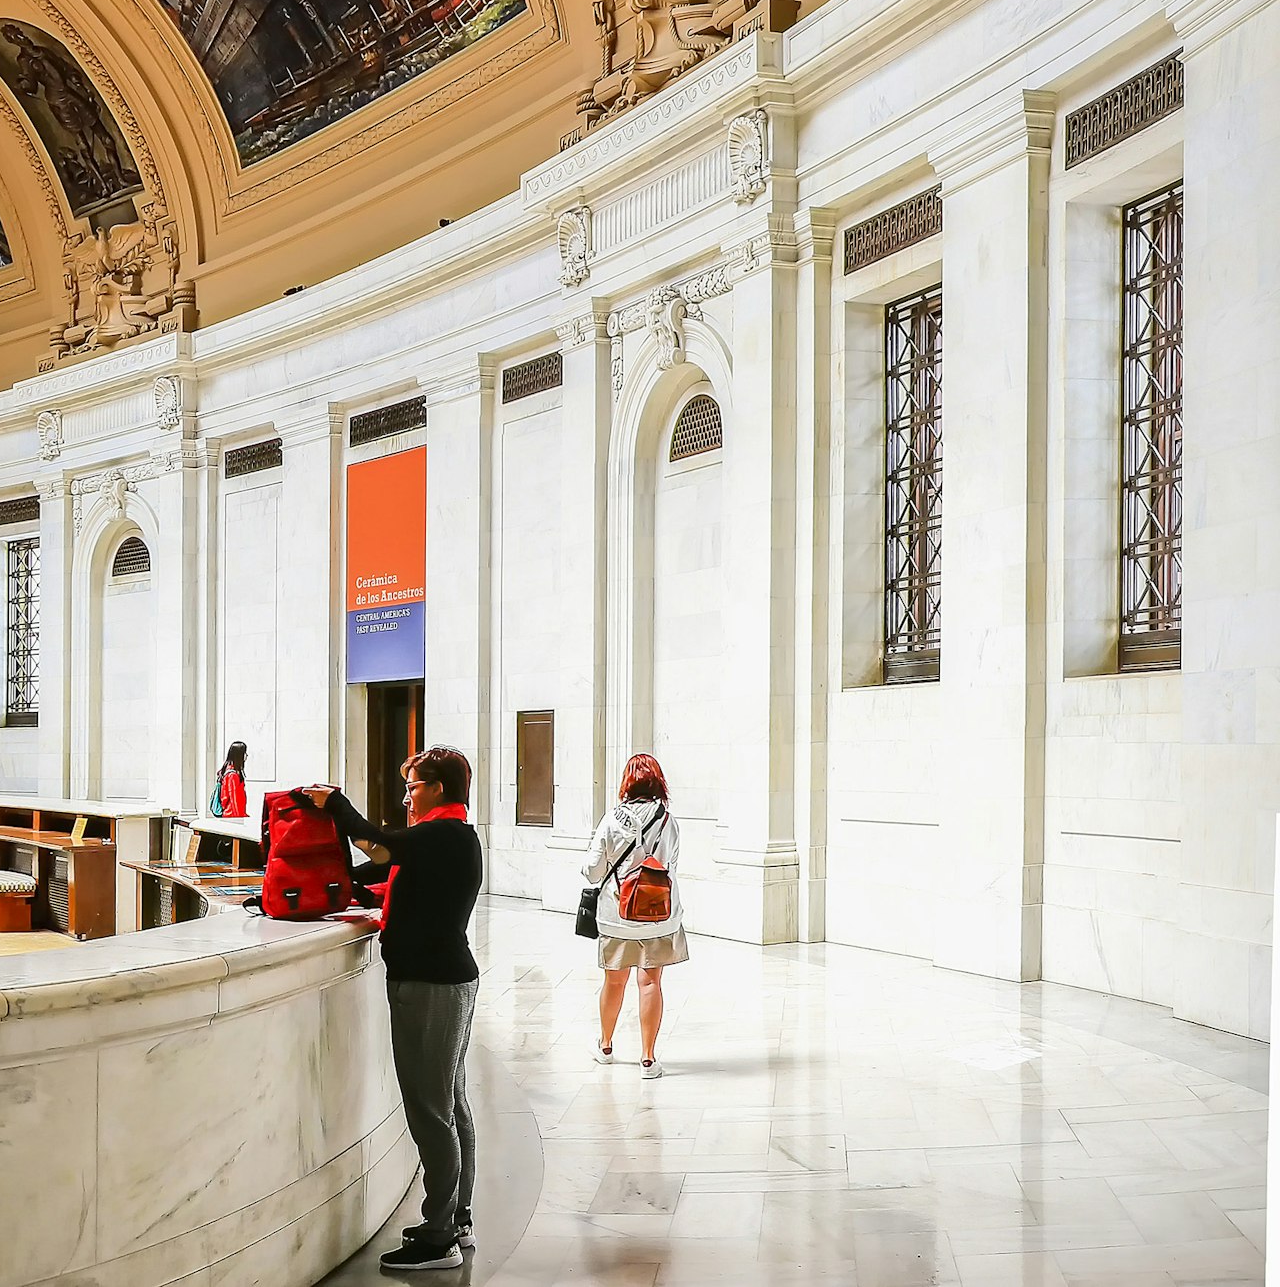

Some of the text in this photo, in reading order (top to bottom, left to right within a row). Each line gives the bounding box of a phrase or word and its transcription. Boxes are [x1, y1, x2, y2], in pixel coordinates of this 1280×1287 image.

[355, 573, 398, 589] Cerámica
[355, 586, 424, 605] de los Ancestros
[355, 608, 411, 623] CENTRAL AMERICA'S
[356, 621, 398, 634] PAST REVEALED
